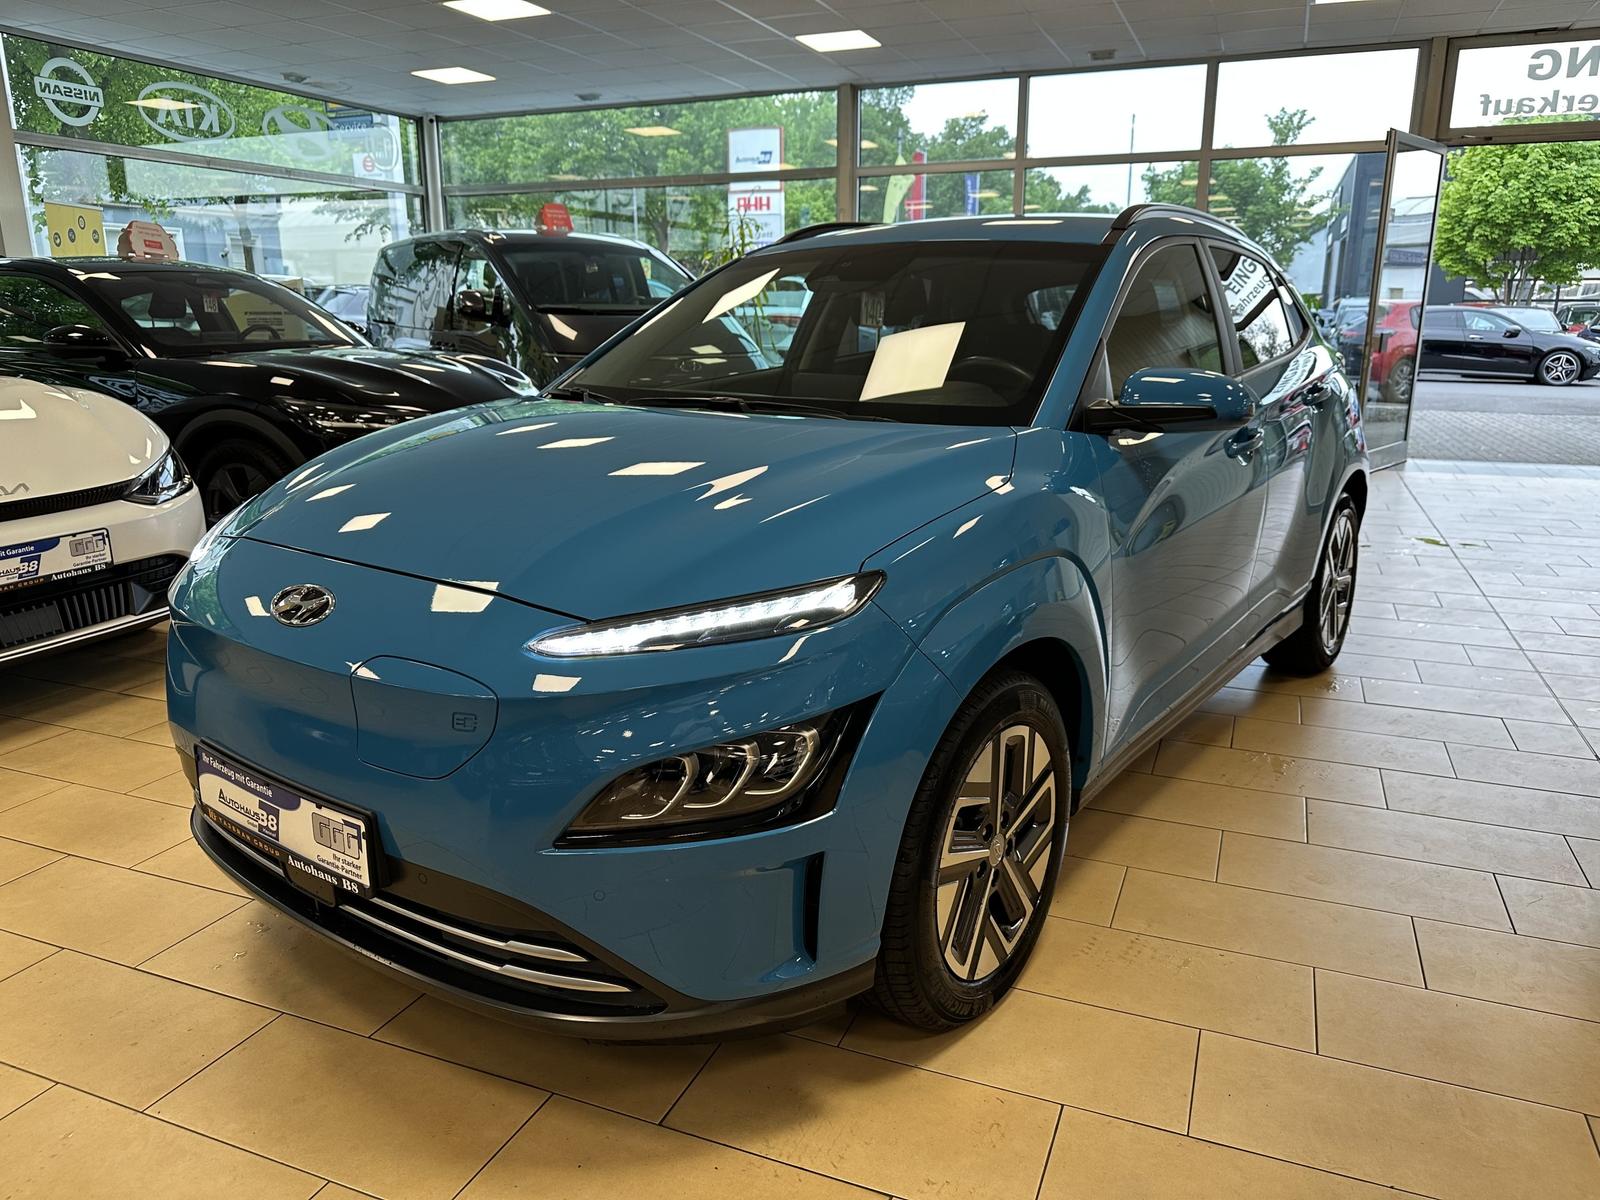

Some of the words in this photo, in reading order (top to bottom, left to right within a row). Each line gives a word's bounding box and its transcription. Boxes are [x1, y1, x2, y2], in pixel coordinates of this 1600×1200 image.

[7, 544, 35, 556] Garantie
[18, 560, 39, 573] B8
[51, 567, 92, 581] Autohaus
[94, 563, 107, 571] B8
[202, 752, 210, 764] Ihr
[209, 757, 235, 780] Fahrzeug
[235, 772, 246, 784] mit
[245, 776, 273, 798] Garantie
[258, 810, 278, 832] B8
[316, 854, 363, 880] Garantie-Partner
[332, 853, 341, 861] Ihr
[341, 857, 362, 871] starker
[288, 855, 338, 885] Autohaus
[341, 878, 359, 894] B8
